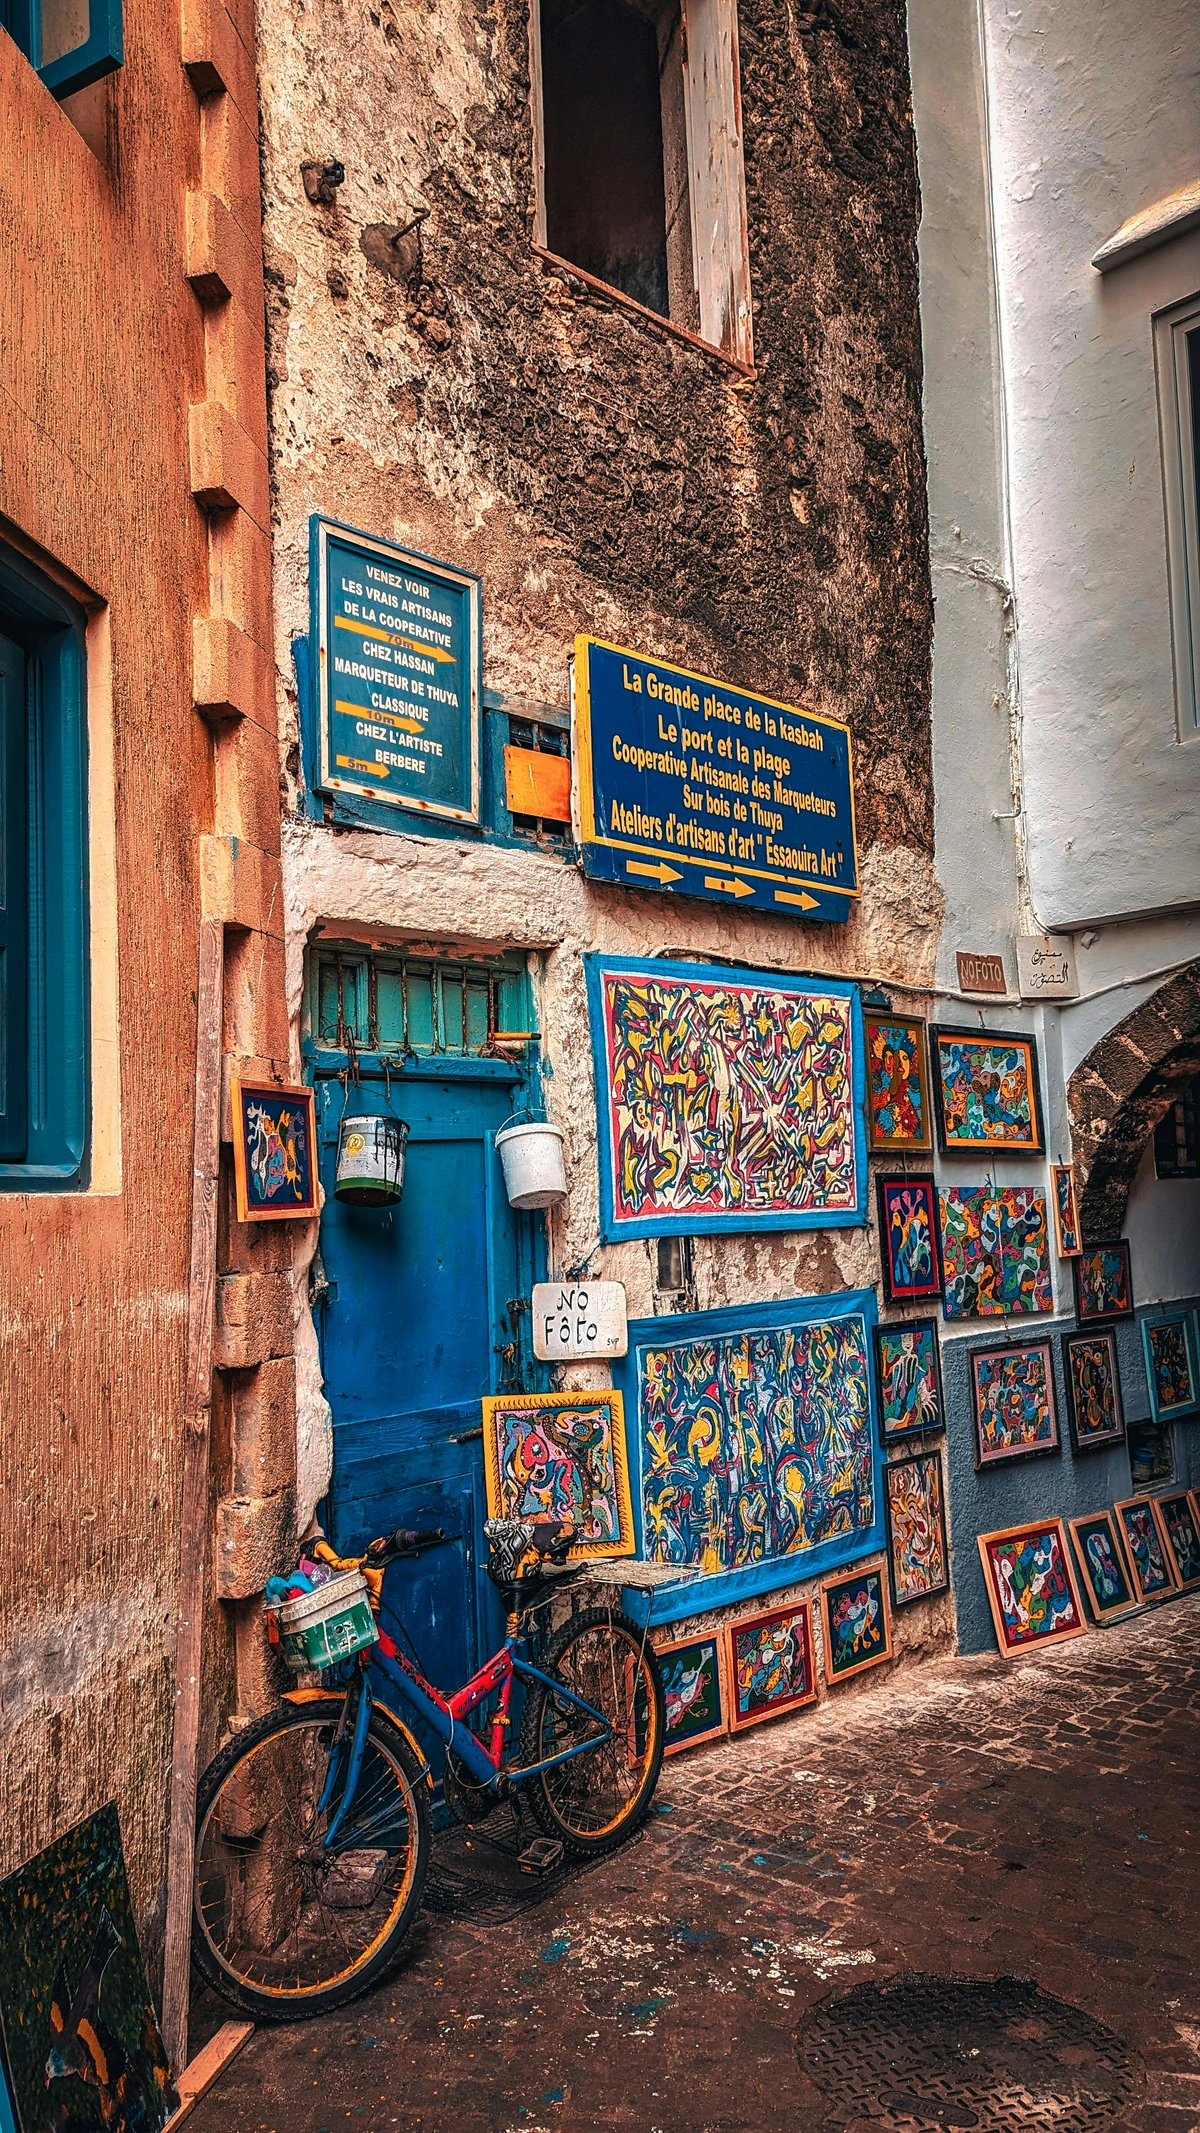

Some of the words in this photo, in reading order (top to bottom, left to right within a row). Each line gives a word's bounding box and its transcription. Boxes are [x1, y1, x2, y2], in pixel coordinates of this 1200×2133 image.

[366, 564, 402, 589] VENEZ
[404, 579, 430, 599] VOIR
[341, 578, 362, 597] LES
[365, 584, 399, 608] VRAIS
[401, 595, 452, 627] ARTISANS
[344, 600, 359, 617] DE
[362, 605, 377, 623] LA
[379, 610, 451, 648] COOPERATIVE
[386, 633, 414, 650] 70m
[363, 640, 392, 663] CHEZ
[394, 650, 435, 676] HASSAN
[335, 657, 409, 692] MARQUETEUR
[411, 678, 425, 696] DE
[426, 683, 459, 708] THUYA
[366, 709, 395, 726] 10m
[371, 692, 429, 722] CLASSIQUE
[622, 663, 642, 694] La
[646, 673, 700, 712] Grande
[704, 693, 741, 725] place
[745, 706, 761, 732] de
[764, 711, 777, 737] la
[779, 716, 823, 752] kasbah
[356, 721, 387, 742] CHEZ
[389, 730, 443, 757] L'ARTISTE
[658, 714, 678, 743] Le
[682, 728, 713, 754] port
[717, 733, 733, 759] et
[736, 738, 749, 765] la
[753, 745, 791, 778] plage
[347, 757, 368, 772] 5m
[375, 748, 426, 774] BERBERE
[612, 735, 688, 778] Cooperative
[690, 756, 749, 795] Artisanale
[751, 775, 771, 801] des
[773, 779, 837, 818] Marqueteurs
[683, 784, 704, 812] Sur
[706, 789, 730, 818] bois
[733, 795, 748, 823] de
[750, 801, 783, 835] Thuya
[611, 799, 662, 841] Ateliers
[665, 813, 726, 855] d'artisans
[728, 827, 756, 861] d'art
[766, 836, 819, 874] Essaouira
[556, 1289, 589, 1311] NO
